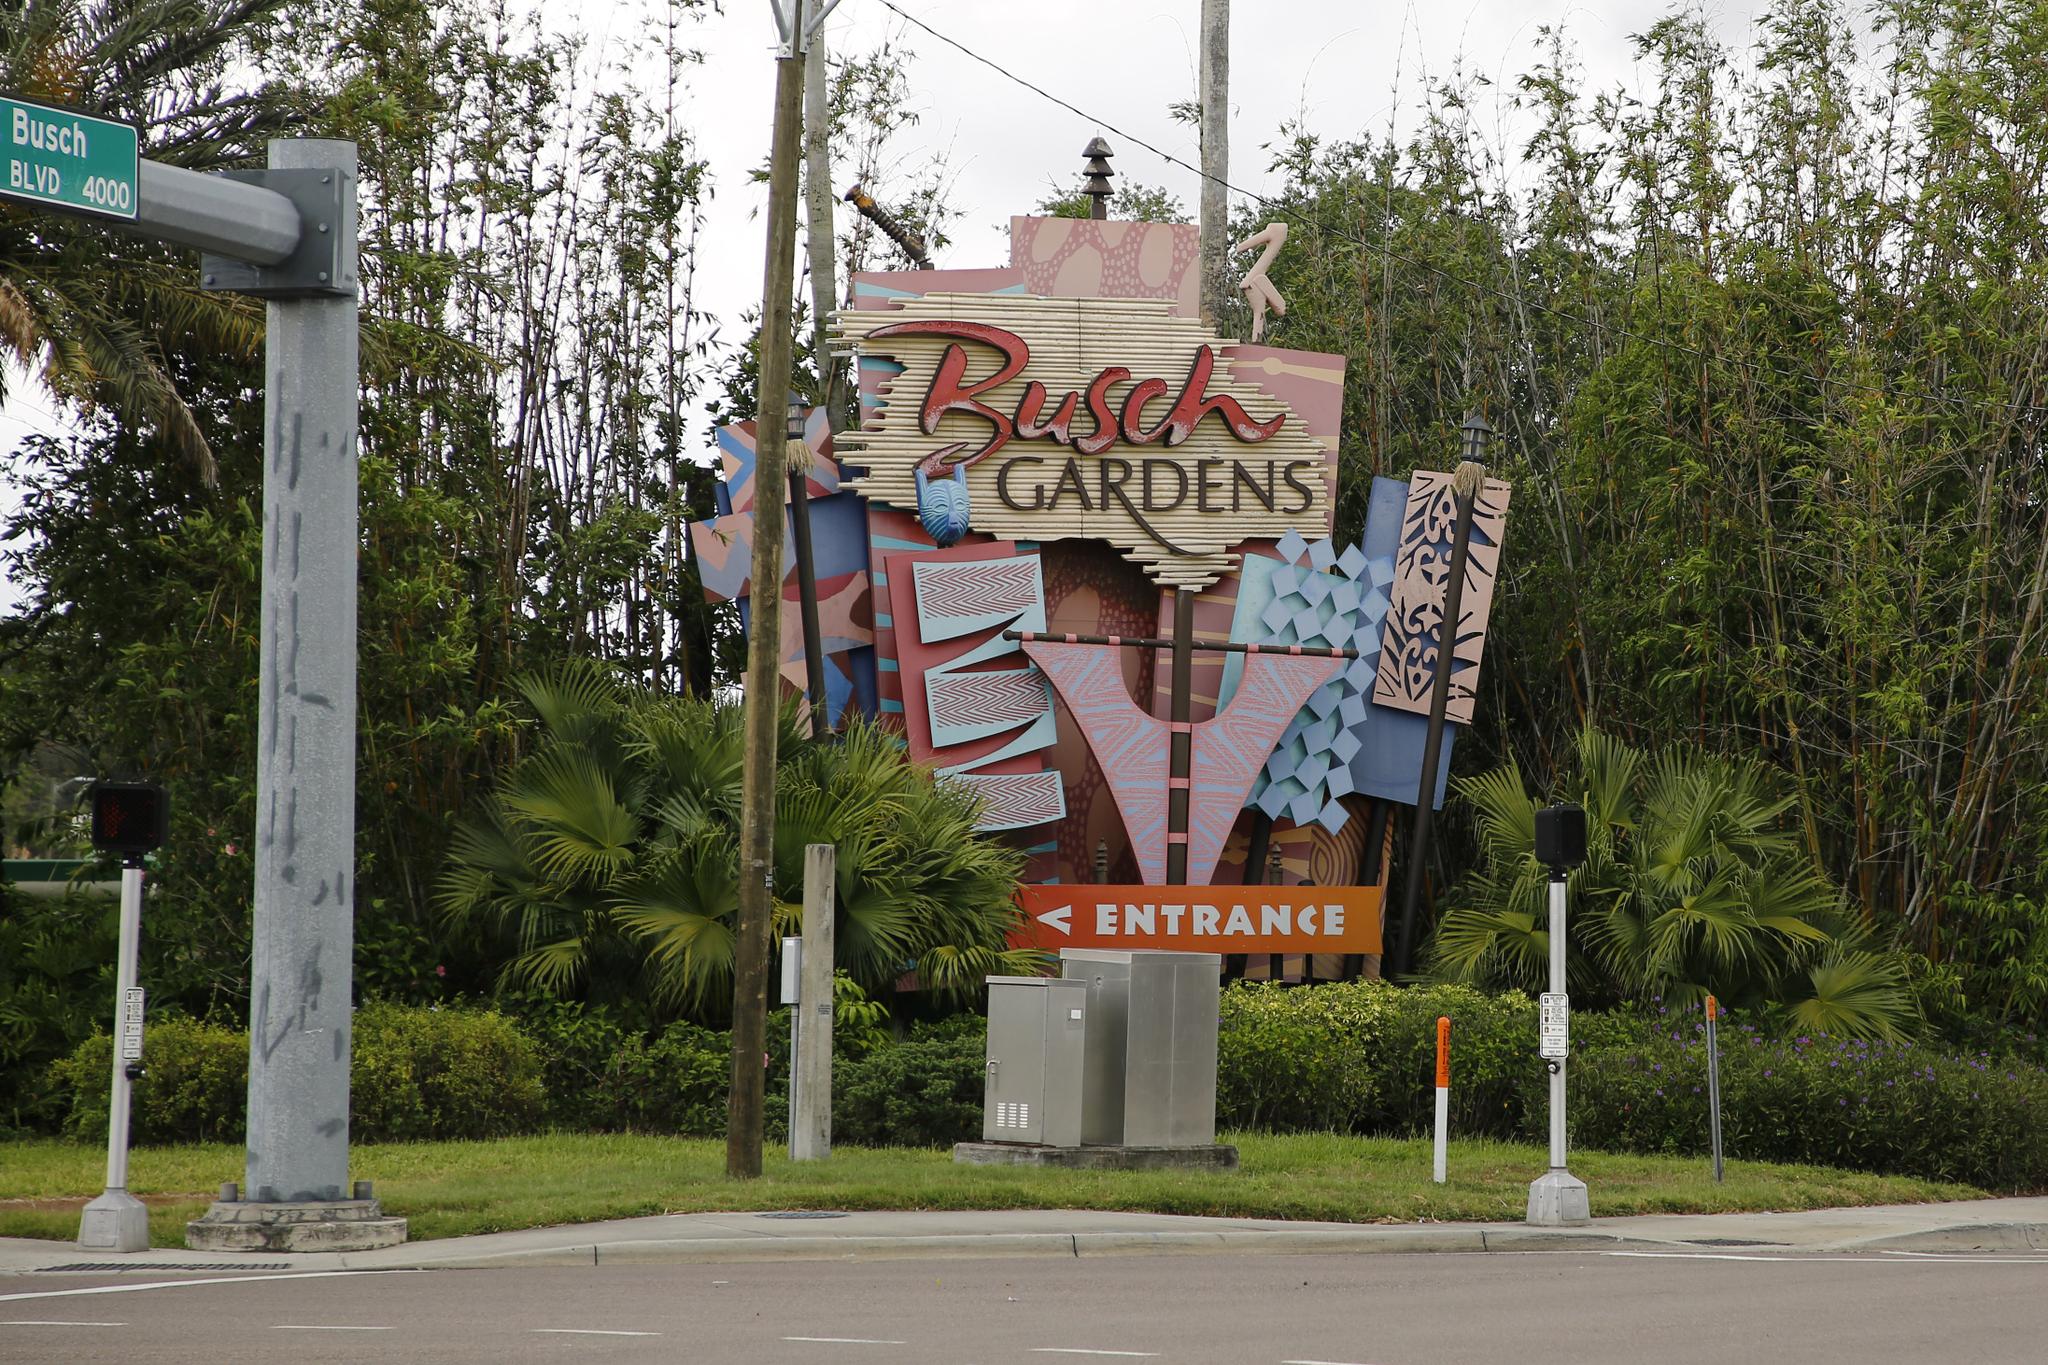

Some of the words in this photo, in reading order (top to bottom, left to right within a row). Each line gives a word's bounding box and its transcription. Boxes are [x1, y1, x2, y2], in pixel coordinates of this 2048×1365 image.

[12, 107, 87, 159] Busch
[10, 159, 60, 195] BLVD
[82, 175, 130, 209] 4000
[862, 320, 1287, 477] Busch
[996, 455, 1317, 556] GARDENS
[1095, 903, 1346, 937] ENTRANCE
